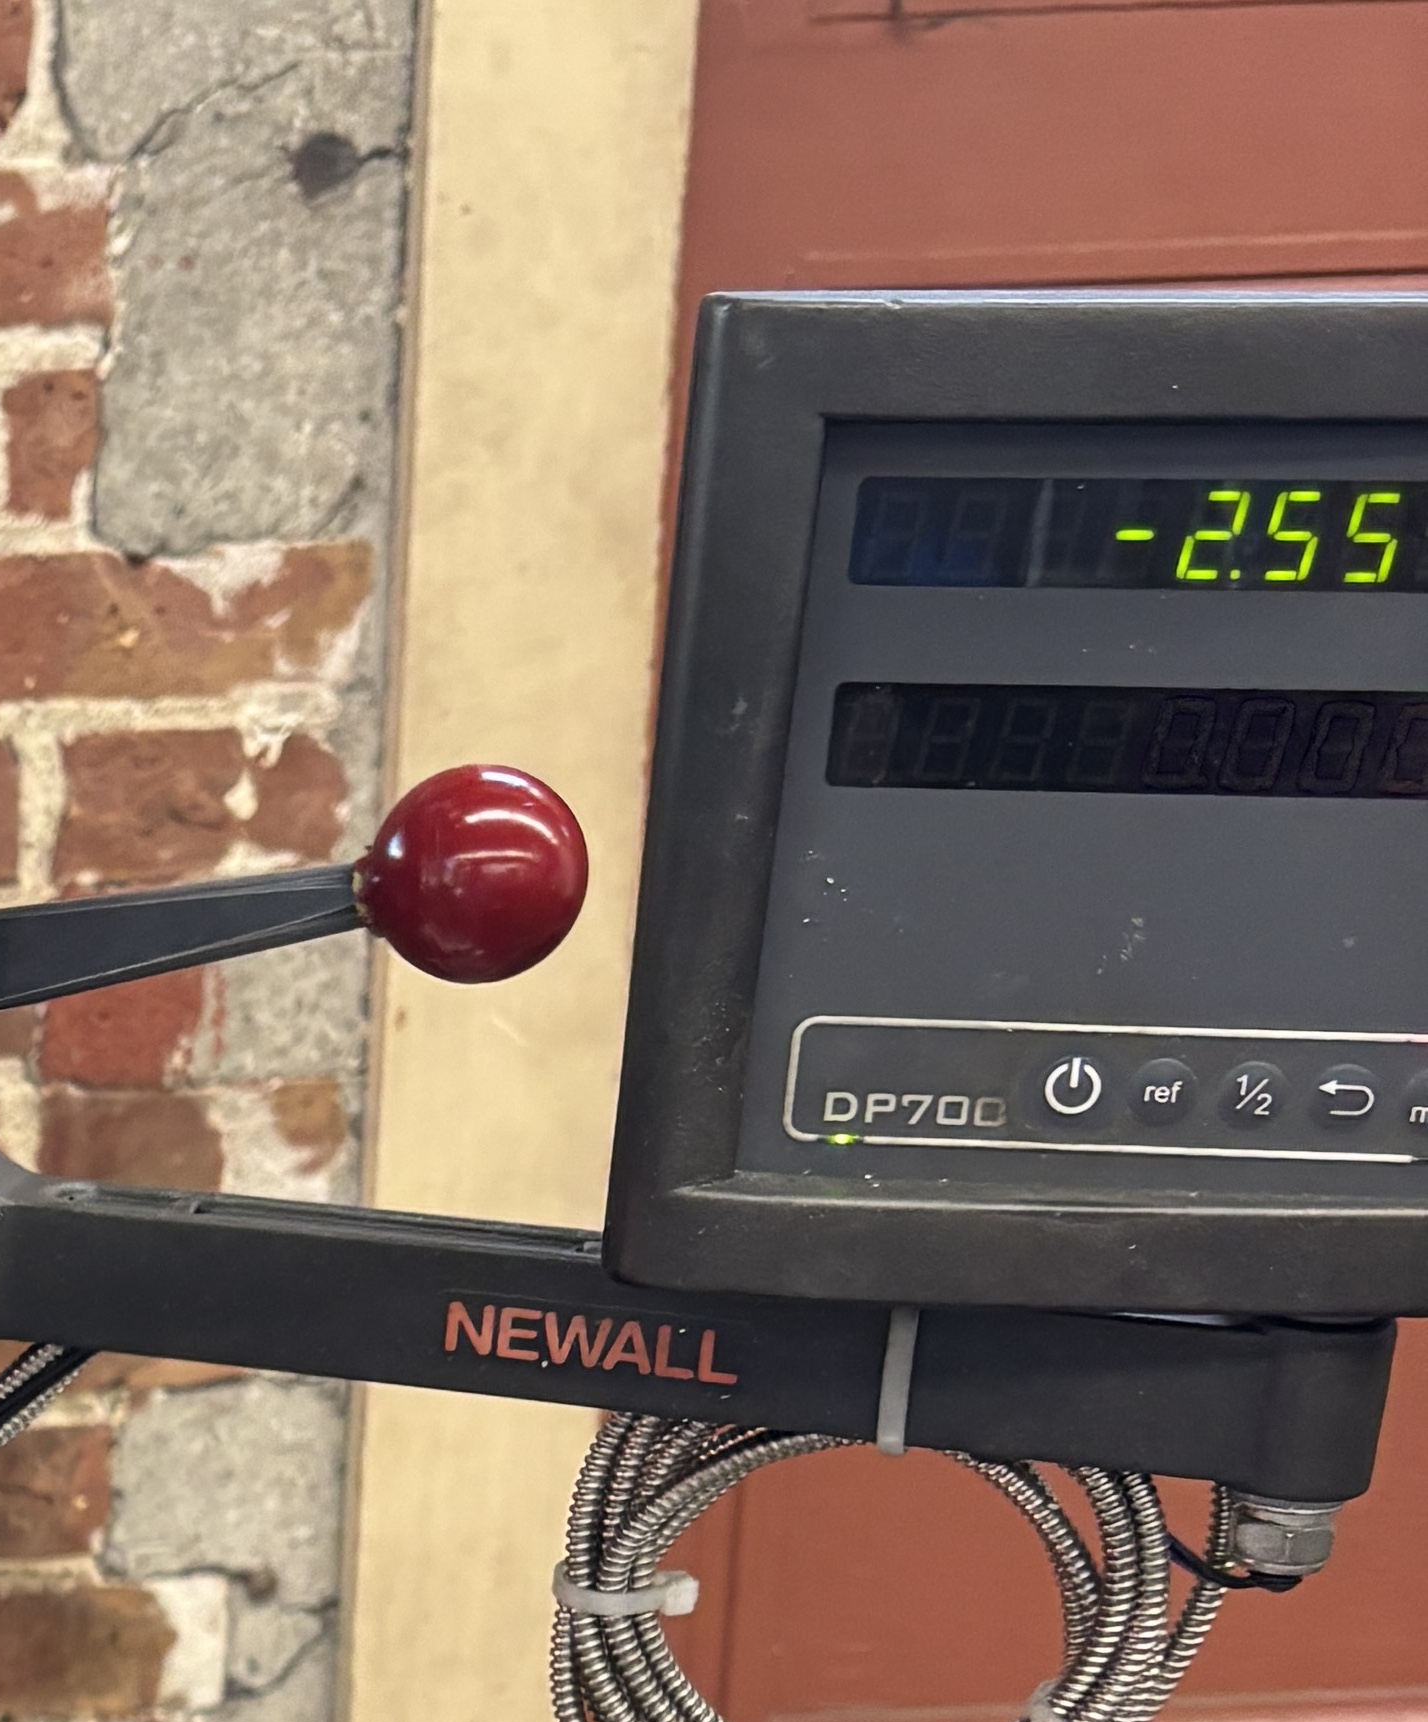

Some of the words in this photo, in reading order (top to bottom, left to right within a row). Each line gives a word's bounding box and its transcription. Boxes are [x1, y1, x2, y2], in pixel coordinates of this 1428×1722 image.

[1115, 489, 1401, 584] -2.55
[822, 1090, 1008, 1129] DP700
[1143, 1080, 1184, 1104] ref
[444, 1300, 739, 1386] NEWALL
